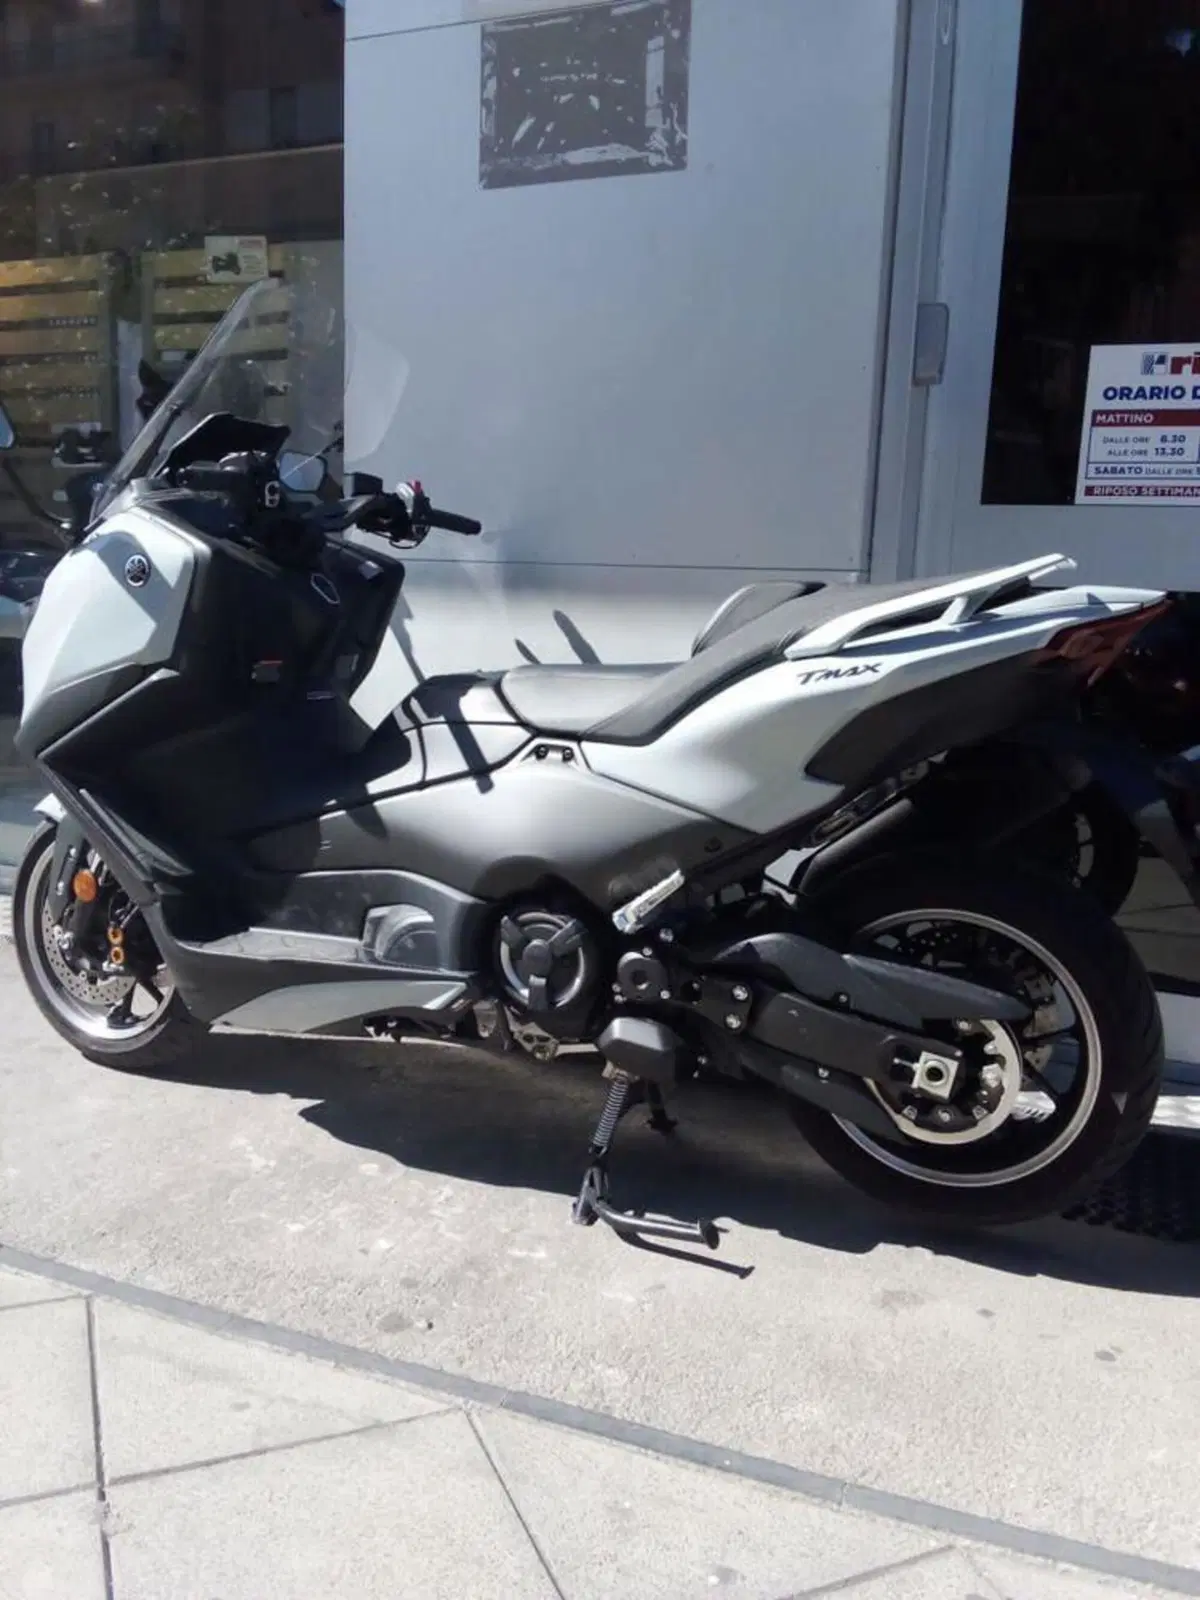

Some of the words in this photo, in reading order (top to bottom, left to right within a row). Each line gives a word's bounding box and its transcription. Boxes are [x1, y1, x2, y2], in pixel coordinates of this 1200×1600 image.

[1103, 385, 1186, 401] ORARIO
[1095, 413, 1154, 424] MATTINO
[1103, 436, 1129, 444] DALLE
[1154, 447, 1185, 456] 13.30
[1094, 466, 1143, 475] SABATO
[1093, 486, 1138, 496] RIPOSO
[796, 661, 883, 685] TMAX
